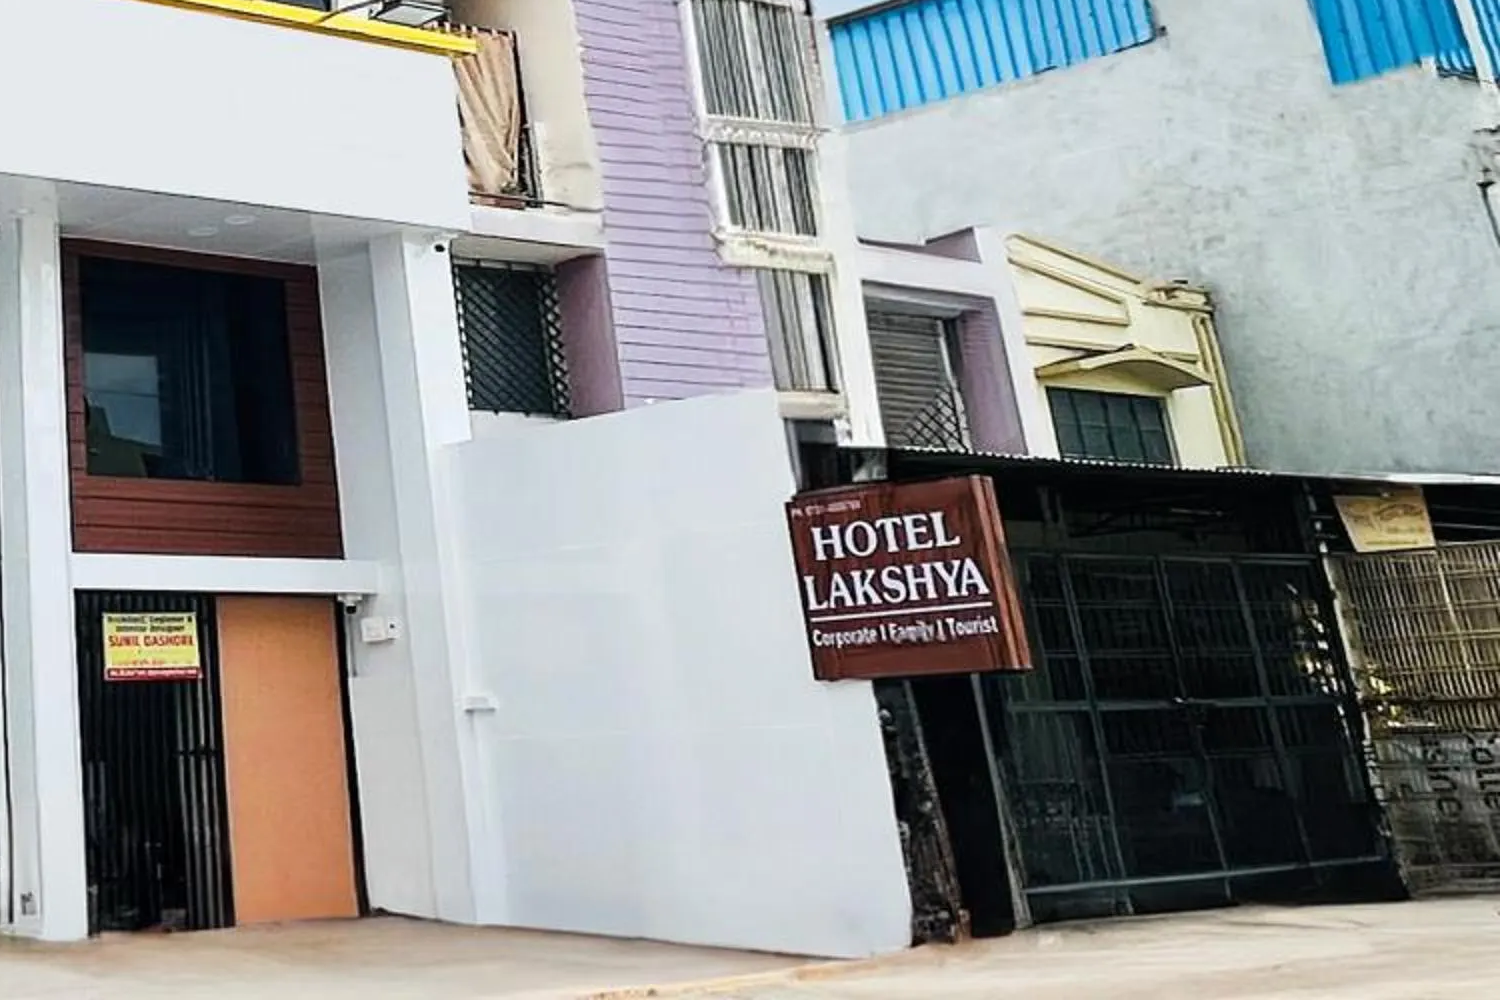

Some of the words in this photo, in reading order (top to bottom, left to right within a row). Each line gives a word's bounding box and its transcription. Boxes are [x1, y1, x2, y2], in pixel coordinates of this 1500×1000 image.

[810, 511, 961, 562] HOTEL
[803, 557, 990, 611] LAKSHYA
[812, 624, 878, 649] Corporate
[889, 621, 935, 643] Family
[946, 615, 999, 638] Tourist
